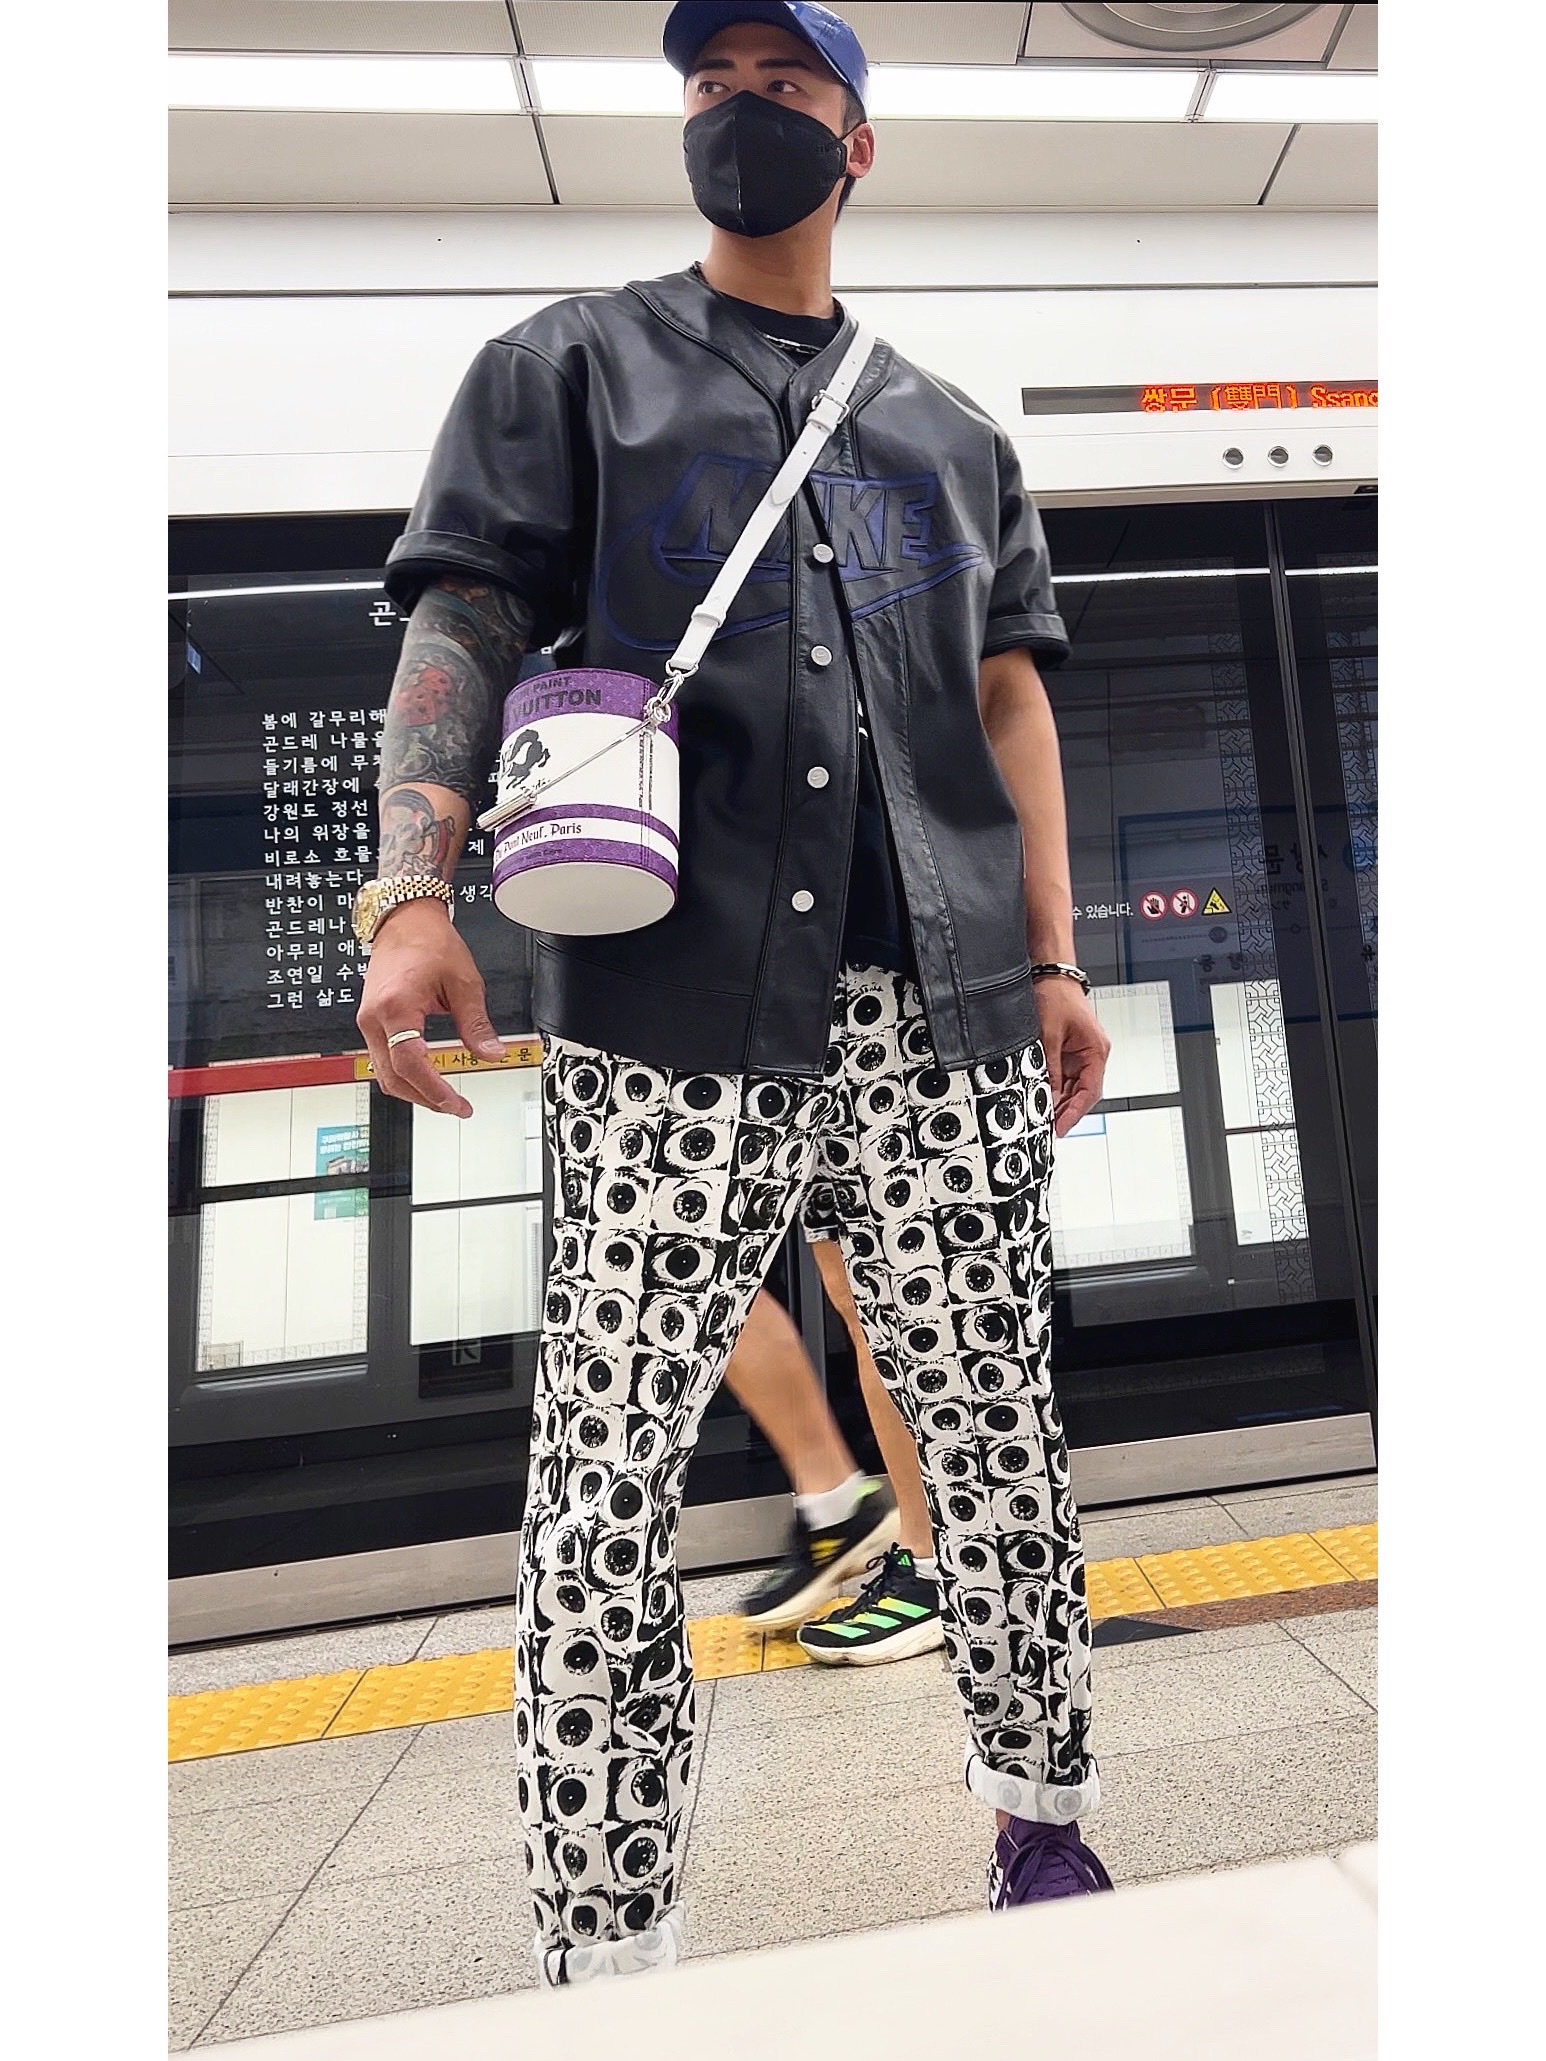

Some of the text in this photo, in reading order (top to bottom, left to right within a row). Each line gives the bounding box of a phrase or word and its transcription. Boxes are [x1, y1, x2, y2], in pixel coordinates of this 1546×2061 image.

[1142, 386, 1197, 412] 쌍문
[657, 455, 936, 572] NKE
[369, 602, 410, 626] 곤
[533, 676, 573, 693] PAINT
[262, 709, 386, 730] 봄에 갈무리해
[262, 734, 318, 753] 곤드레
[263, 755, 337, 776] 들기름에
[263, 777, 359, 799] 달래간장에
[263, 799, 368, 821] 강원도 정선
[264, 822, 370, 843] 나의 위장을
[549, 823, 582, 836] Paris
[265, 839, 484, 867] 비로소 흐물 제
[265, 869, 364, 891] 내려놓는다
[265, 894, 323, 915] 반찬이
[337, 892, 355, 910] 마
[1072, 902, 1134, 921] 수 있습니다.
[266, 916, 358, 939] 곤드레나
[266, 941, 324, 962] 아무리
[267, 965, 323, 985] 조연일
[267, 988, 355, 1009] 그런 삶도
[517, 1048, 532, 1062] 문
